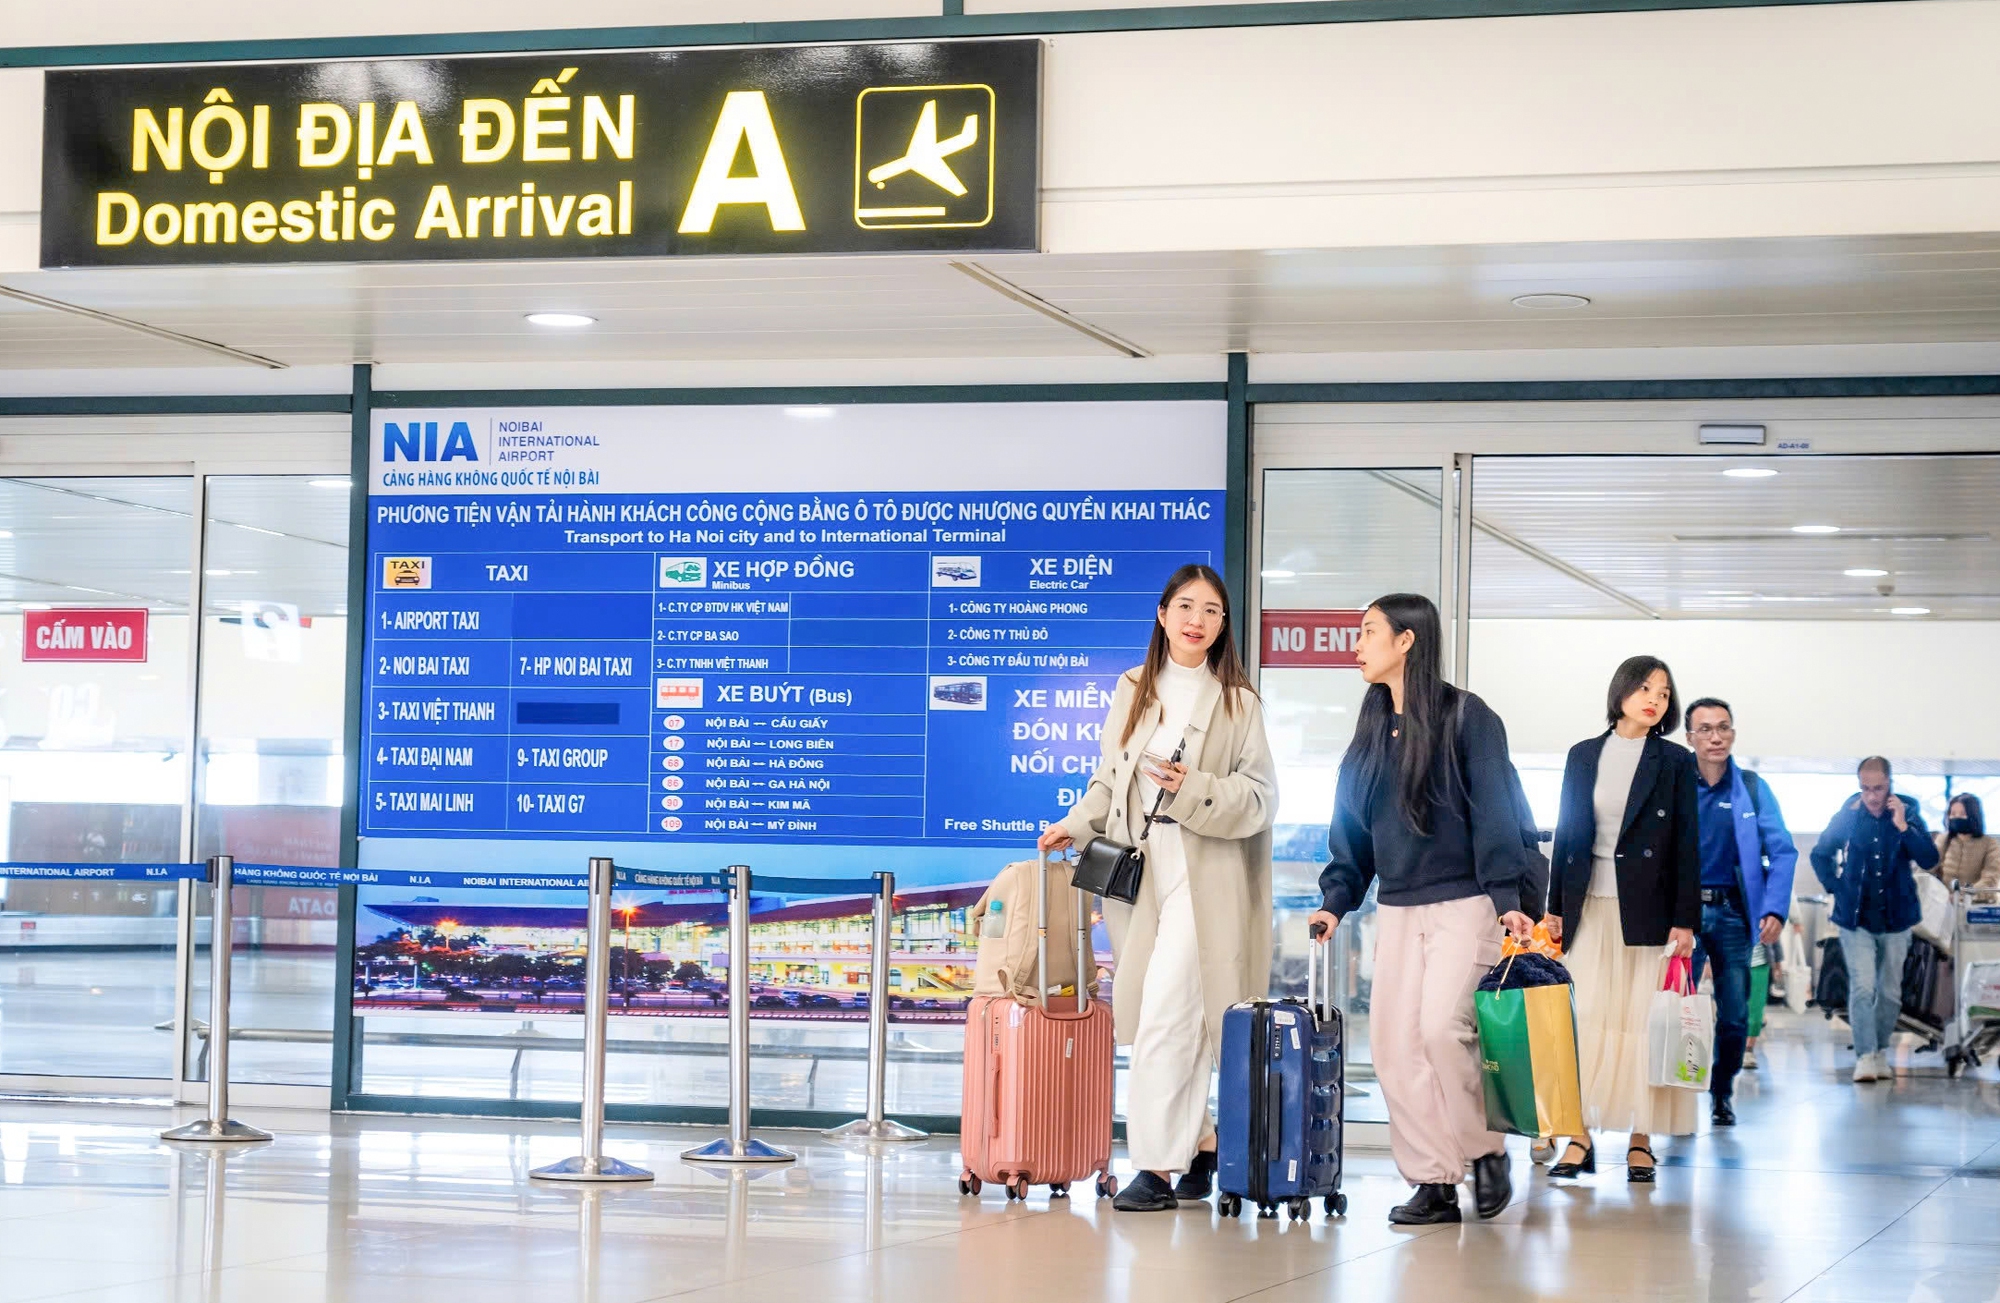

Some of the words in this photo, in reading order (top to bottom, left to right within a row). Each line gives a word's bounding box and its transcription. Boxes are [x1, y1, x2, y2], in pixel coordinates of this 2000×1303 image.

[132, 88, 270, 183] NỘI
[297, 101, 433, 179] ĐỊA
[459, 67, 634, 161] ĐẾN
[678, 91, 805, 233] A
[96, 185, 396, 245] Domestic
[415, 181, 633, 239] Arrival
[498, 421, 542, 432] NOIBAI
[384, 422, 478, 462] NIA
[498, 435, 600, 447] INTERNATIONAL
[497, 450, 554, 461] AIRPORT
[418, 469, 451, 486] HÀNG
[455, 469, 498, 486] KHÔNG
[501, 467, 534, 487] QUỐC
[537, 467, 551, 486] TẾ
[553, 468, 575, 488] NỘI
[579, 469, 599, 485] BÀI
[377, 504, 449, 523] PHƯƠNG
[454, 501, 490, 527] TIỆN
[496, 501, 530, 526] VẬN
[536, 498, 562, 522] TẢI
[568, 499, 615, 522] HÀNH
[621, 500, 681, 521] KHÁCH
[687, 499, 737, 521] CÔNG
[743, 499, 793, 526] CỘNG
[799, 496, 849, 520] BẰNG
[855, 498, 867, 520] Ô
[873, 498, 897, 520] TÔ
[902, 501, 953, 525] ĐƯỢC
[960, 500, 1036, 525] NHƯỢNG
[1043, 495, 1105, 521] QUYỀN
[1112, 502, 1154, 519] KHAI
[1161, 497, 1210, 519] THÁC
[564, 530, 643, 546] Transport
[647, 530, 664, 542] to
[669, 530, 690, 542] Ha
[696, 529, 723, 542] Noi
[728, 529, 758, 546] city
[763, 529, 794, 542] and
[799, 530, 816, 542] to
[821, 529, 926, 542] International
[932, 528, 1005, 541] Terminal
[390, 560, 424, 568] TAXI
[713, 561, 739, 577] XE
[746, 559, 788, 581] HỢP
[793, 554, 853, 577] ĐỒNG
[1029, 558, 1058, 576] XE
[1062, 554, 1113, 580] ĐIỆN
[485, 565, 527, 581] TAXI
[711, 580, 750, 589] Minibus
[1029, 580, 1068, 589] Electric
[1070, 580, 1089, 589] Car
[668, 602, 688, 612] C.TY
[690, 602, 703, 612] CP
[730, 602, 743, 612] HK
[745, 599, 766, 612] VIỆT
[767, 602, 788, 612] NAM
[960, 600, 990, 613] CÔNG
[993, 603, 1006, 613] TY
[1009, 600, 1047, 613] HOÀNG
[1050, 603, 1087, 613] PHONG
[394, 611, 449, 629] AIRPORT
[451, 611, 479, 629] TAXI
[36, 618, 84, 650] CẤM
[90, 620, 132, 650] VÀO
[668, 630, 689, 641] C.TY
[690, 630, 702, 641] CP
[704, 630, 718, 641] BA
[719, 630, 740, 641] SAO
[960, 626, 991, 640] CÔNG
[993, 629, 1006, 640] TY
[1009, 626, 1030, 640] THỦ
[1032, 626, 1049, 640] ĐÔ
[1271, 626, 1306, 652] NO
[1314, 627, 1360, 652] ENT
[393, 656, 414, 674] NOI
[417, 656, 438, 674] BAI
[441, 656, 469, 674] TAXI
[534, 656, 551, 675] HP
[554, 656, 576, 675] NOI
[579, 656, 600, 675] BAI
[603, 657, 632, 675] TAXI
[667, 658, 688, 669] C.TY
[689, 658, 714, 669] TNHH
[716, 655, 736, 672] VIỆT
[737, 658, 769, 669] THANH
[958, 653, 989, 666] CÔNG
[992, 655, 1005, 665] TY
[1007, 651, 1030, 666] ĐẦU
[1032, 654, 1047, 666] TƯ
[1049, 653, 1068, 669] NỘI
[1070, 652, 1088, 666] BÀI
[716, 685, 743, 701] XE
[749, 681, 804, 702] BUÝT
[809, 688, 851, 706] (Bus)
[1014, 689, 1048, 708] XE
[1055, 682, 1115, 709] MIỄN
[391, 701, 419, 720] TAXI
[422, 697, 450, 724] VIỆT
[452, 701, 494, 720] THANH
[668, 719, 680, 728] 07
[705, 716, 727, 729] NỘI
[729, 716, 749, 728] BÀI
[1012, 717, 1068, 741] ĐÓN
[668, 739, 680, 748] 17
[706, 737, 728, 750] NỘI
[730, 737, 751, 748] BÀI
[769, 739, 803, 749] LONG
[806, 738, 834, 749] BIÊN
[390, 746, 418, 765] TAXI
[420, 747, 441, 770] ĐẠI
[445, 747, 472, 765] NAM
[531, 748, 559, 767] TAXI
[562, 748, 608, 767] GROUP
[706, 756, 727, 769] NỘI
[730, 756, 750, 768] BÀI
[769, 757, 786, 768] HÀ
[789, 757, 824, 768] ĐÔNG
[1010, 747, 1054, 774] NỐI
[706, 776, 727, 790] NỘI
[729, 777, 750, 788] BÀI
[768, 780, 787, 788] GA
[789, 777, 806, 789] HÀ
[809, 778, 830, 791] NỘI
[389, 792, 416, 810] TAXI
[419, 792, 442, 811] MAI
[445, 793, 473, 811] LINH
[537, 794, 565, 812] TAXI
[568, 794, 585, 813] G7
[666, 798, 679, 807] 90
[705, 797, 727, 810] NỘI
[729, 797, 749, 809] BÀI
[768, 800, 790, 809] KIM
[664, 820, 681, 828] 109
[705, 817, 726, 830] NỘI
[728, 818, 749, 829] BÀI
[788, 819, 817, 830] ĐÌNH
[944, 818, 978, 831] Free
[981, 819, 1035, 831] Shuttle
[74, 868, 115, 877] AIRPORT
[146, 868, 168, 876] N.I.A
[463, 877, 497, 886] NOIBAI
[499, 878, 576, 887] INTERNATIONAL
